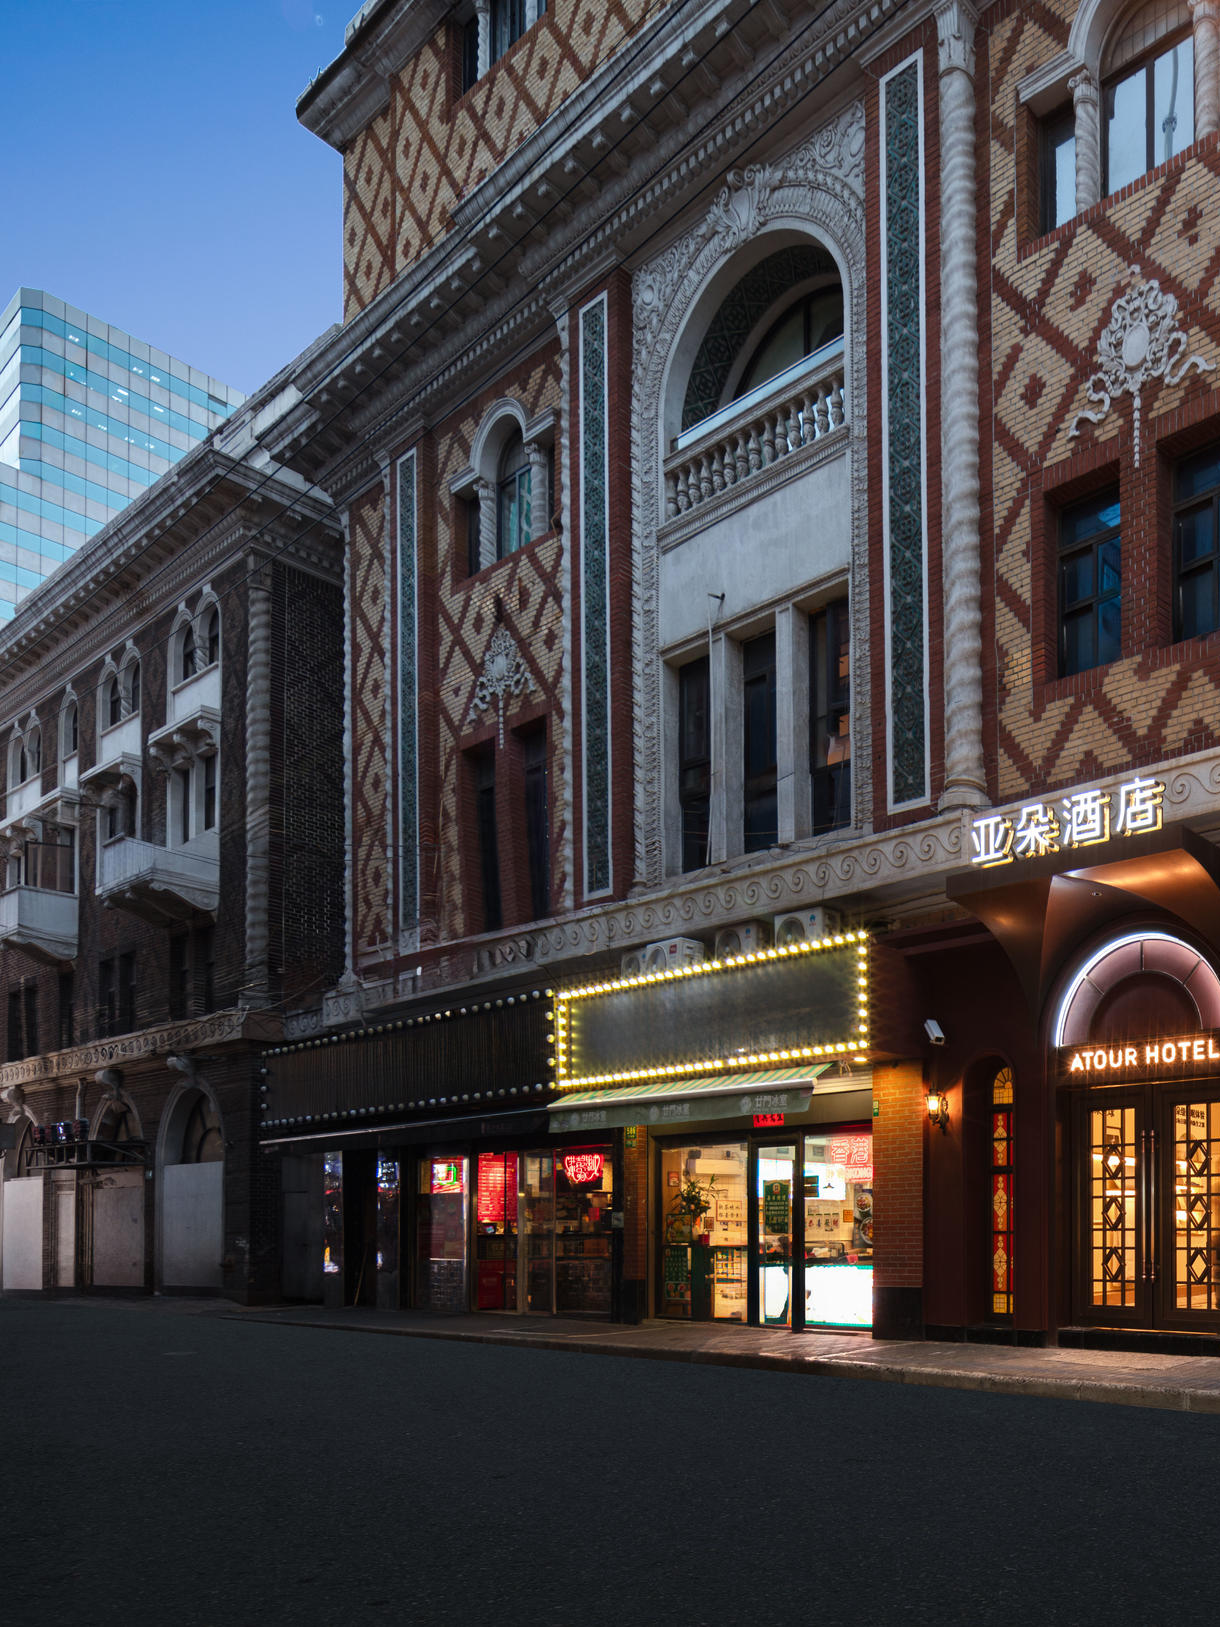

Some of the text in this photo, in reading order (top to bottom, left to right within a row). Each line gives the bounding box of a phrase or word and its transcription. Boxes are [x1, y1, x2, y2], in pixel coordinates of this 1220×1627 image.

[970, 776, 1163, 867] 亚朵酒店
[1070, 1039, 1220, 1072] ATOUR HOTEL
[831, 1137, 869, 1164] 香港
